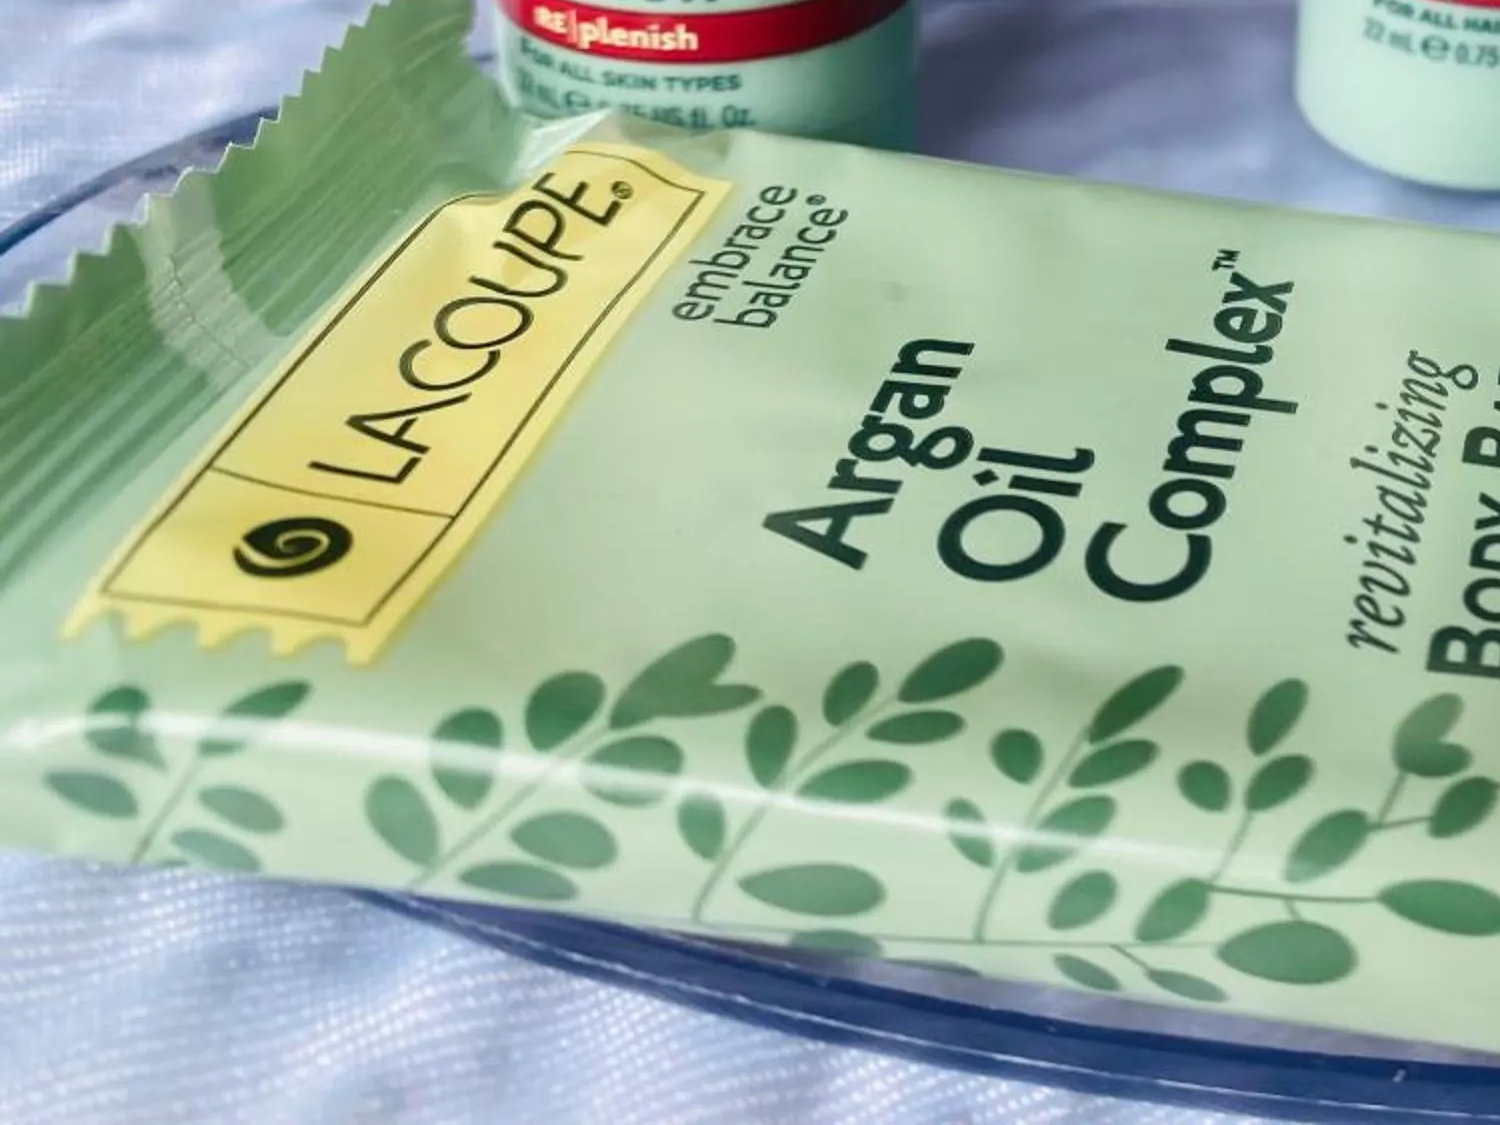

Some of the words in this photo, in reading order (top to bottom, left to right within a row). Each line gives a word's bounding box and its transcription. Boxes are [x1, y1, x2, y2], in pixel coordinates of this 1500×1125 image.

[520, 37, 555, 67] FOR
[561, 62, 595, 84] ALL
[602, 70, 657, 90] SKIN
[662, 73, 743, 92] TYPES
[1418, 9, 1457, 30] ALL
[1455, 41, 1500, 68] 0.75
[672, 183, 798, 322] embrace
[761, 338, 976, 571] Argan
[936, 447, 1096, 583] Oil
[1345, 349, 1479, 655] revitalizing
